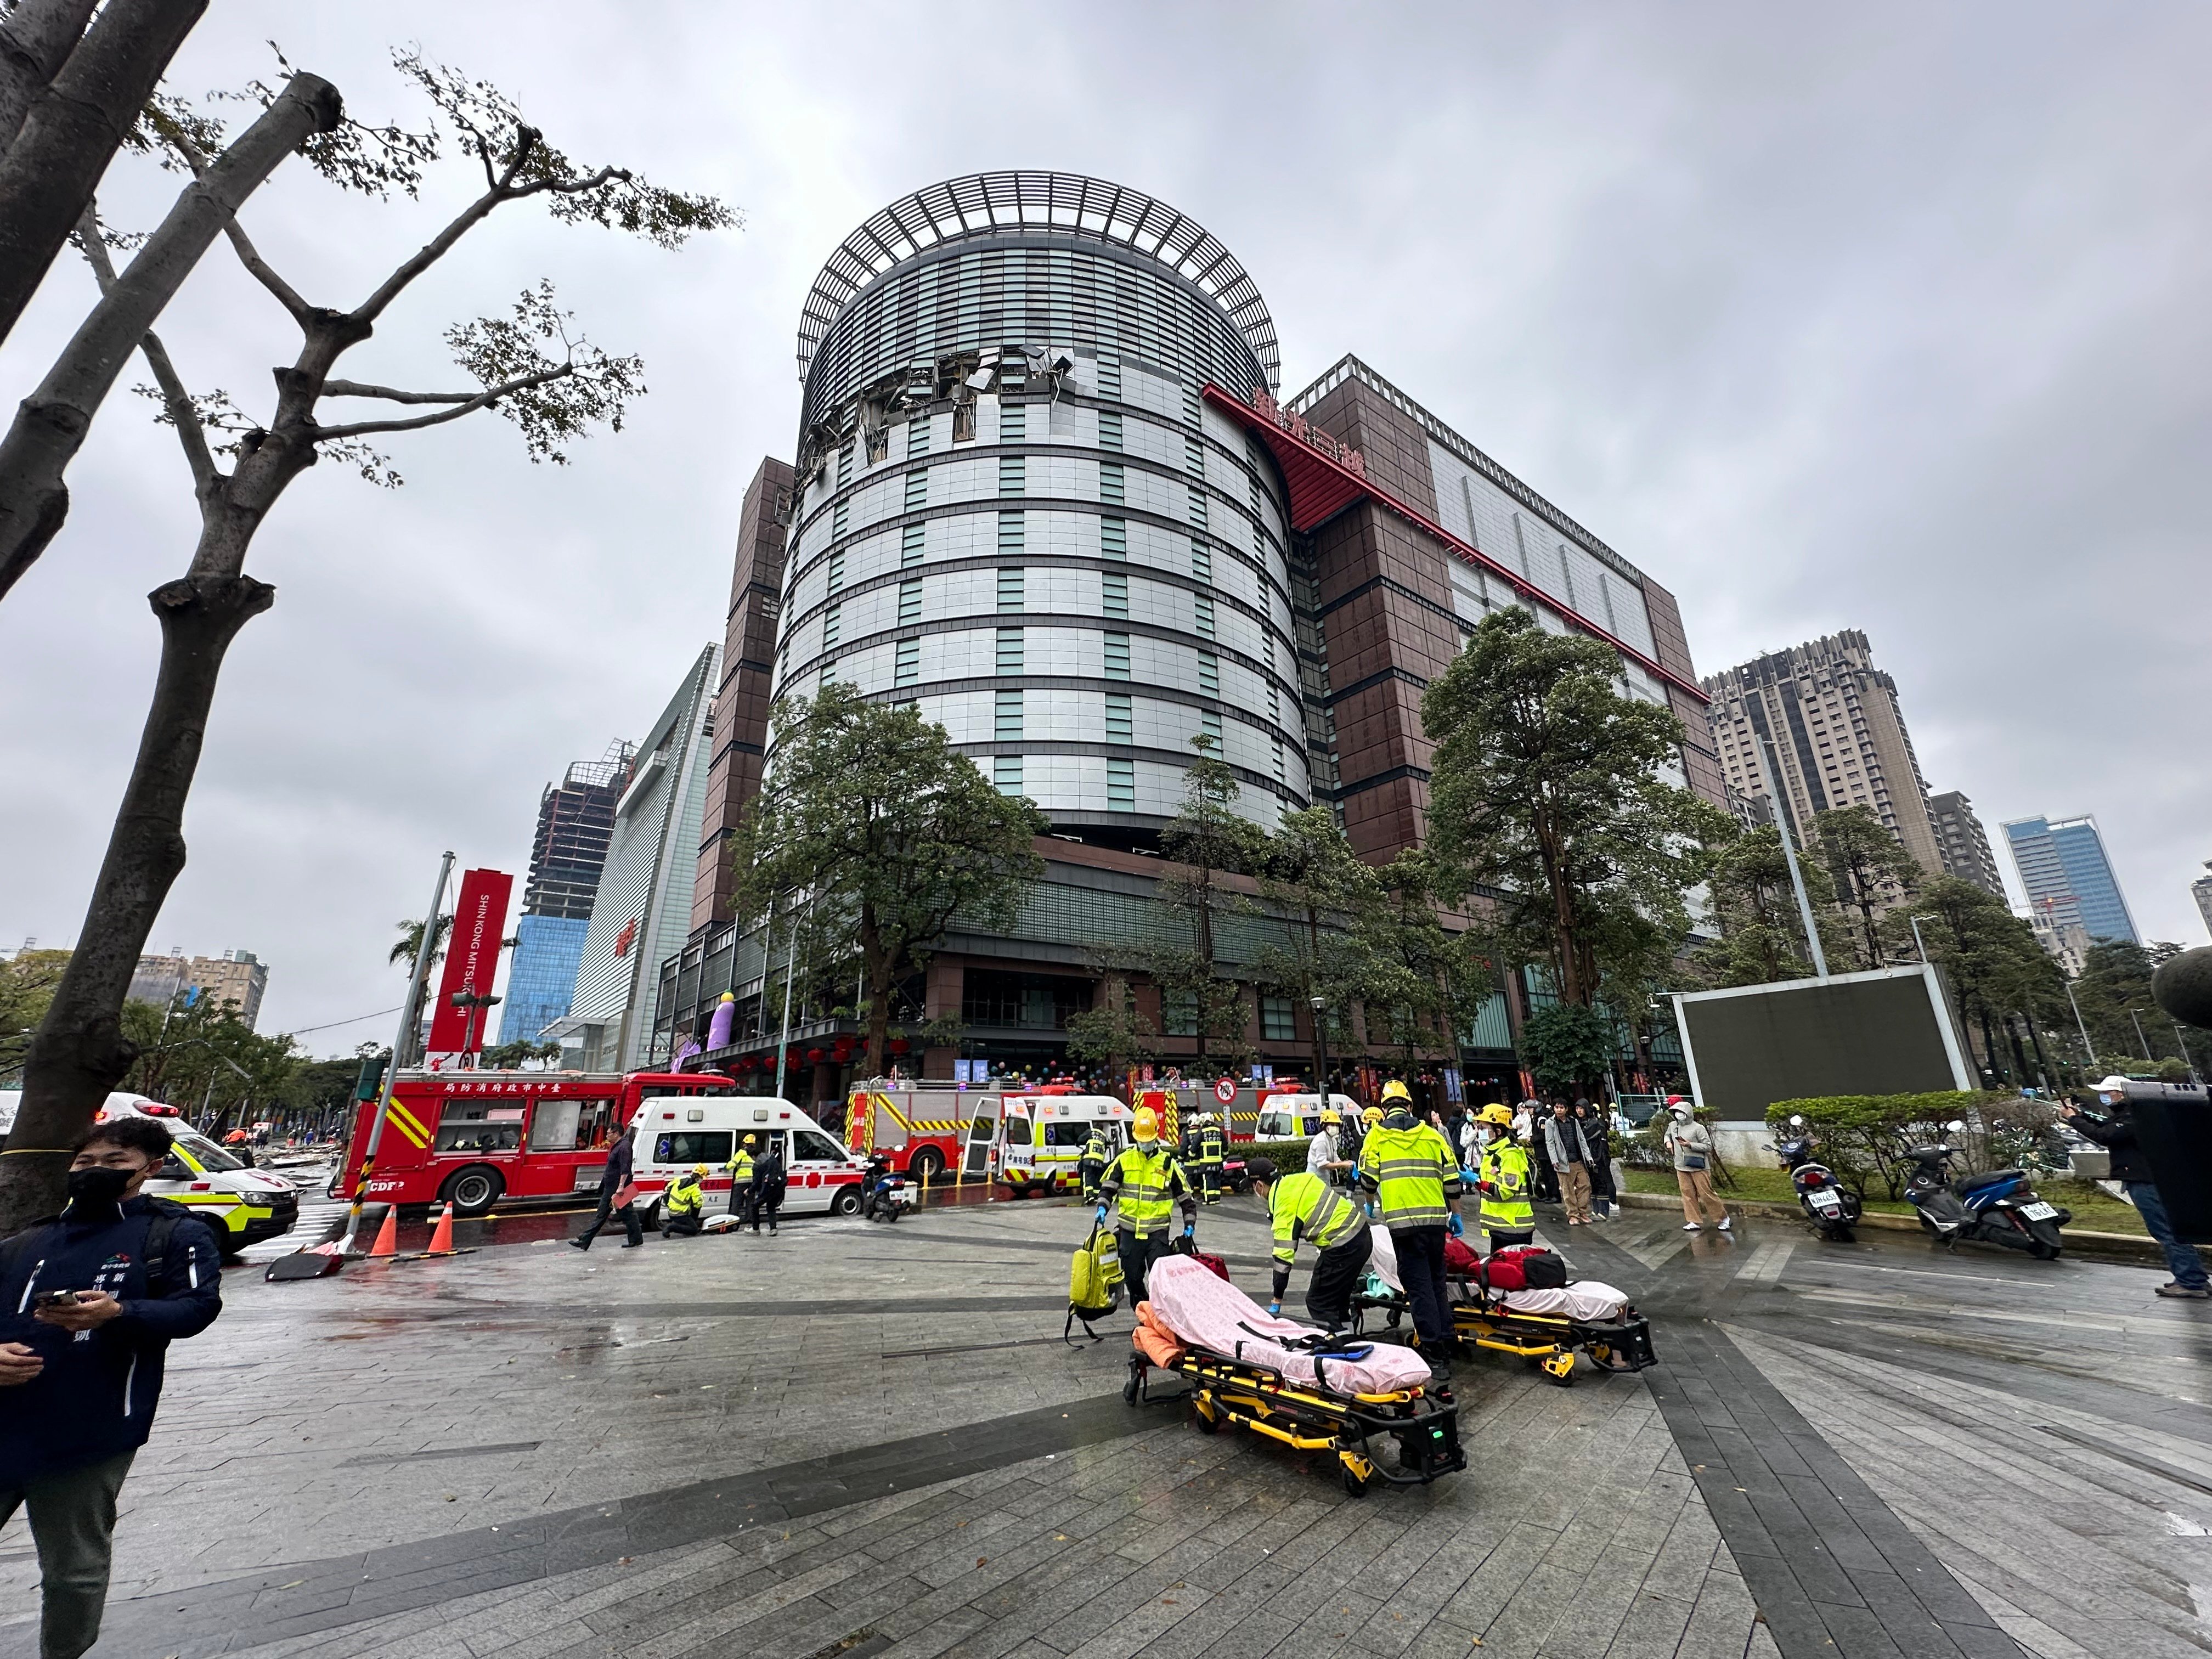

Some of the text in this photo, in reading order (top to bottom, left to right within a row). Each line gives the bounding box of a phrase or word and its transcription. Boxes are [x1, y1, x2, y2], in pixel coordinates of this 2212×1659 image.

[1253, 386, 1367, 479] 新光三越
[457, 894, 489, 1017] SHIN KONG MITSUKHI
